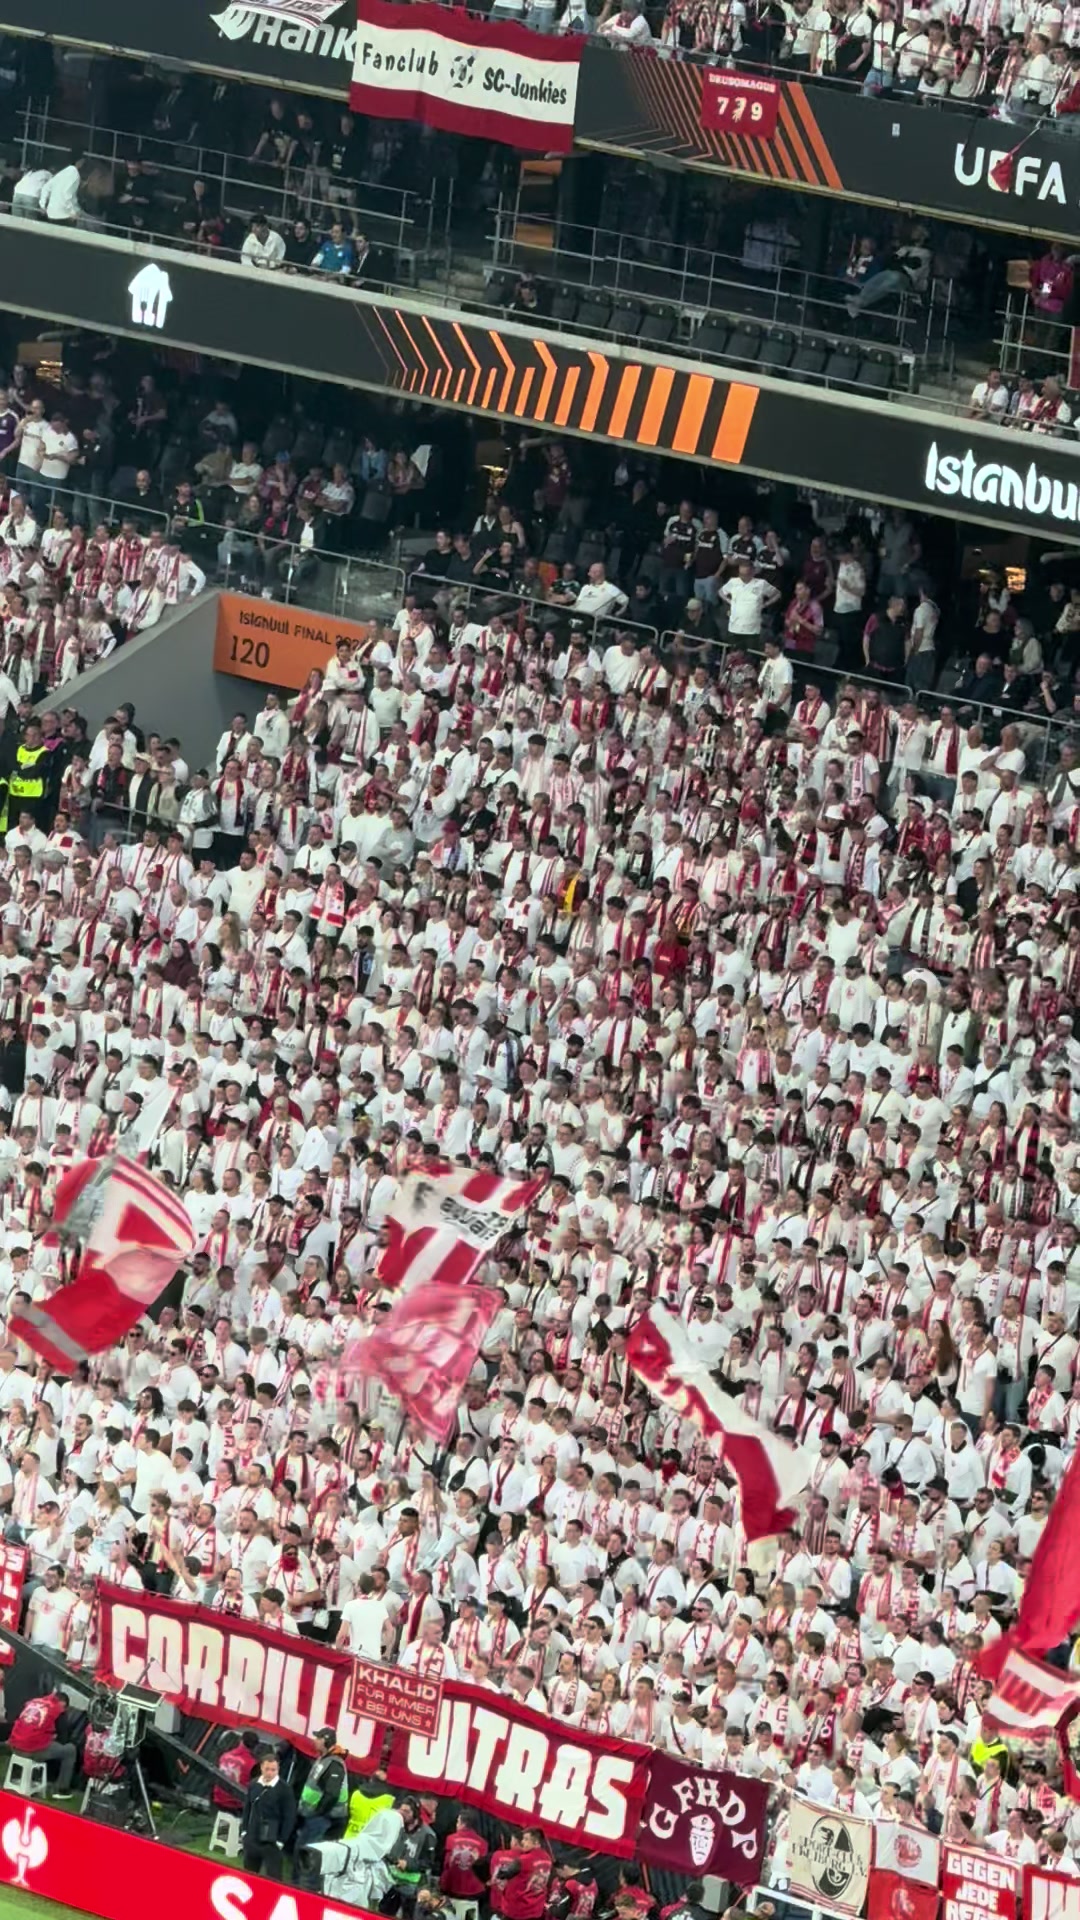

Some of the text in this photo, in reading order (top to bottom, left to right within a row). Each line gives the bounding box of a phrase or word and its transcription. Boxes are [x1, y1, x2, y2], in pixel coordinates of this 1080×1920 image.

[362, 42, 567, 105] Fanclub SC-Junkies
[925, 441, 1080, 521] Istanbu
[230, 635, 270, 668] 120
[294, 625, 332, 645] FINAL
[356, 1683, 435, 1717] FÜR IMMER
[359, 1665, 437, 1701] KHALID
[365, 1700, 422, 1726] BEI UNS
[407, 1697, 634, 1840] ULTRAS
[946, 1851, 1016, 1892] GEGEN
[955, 1879, 999, 1912] JEDE
